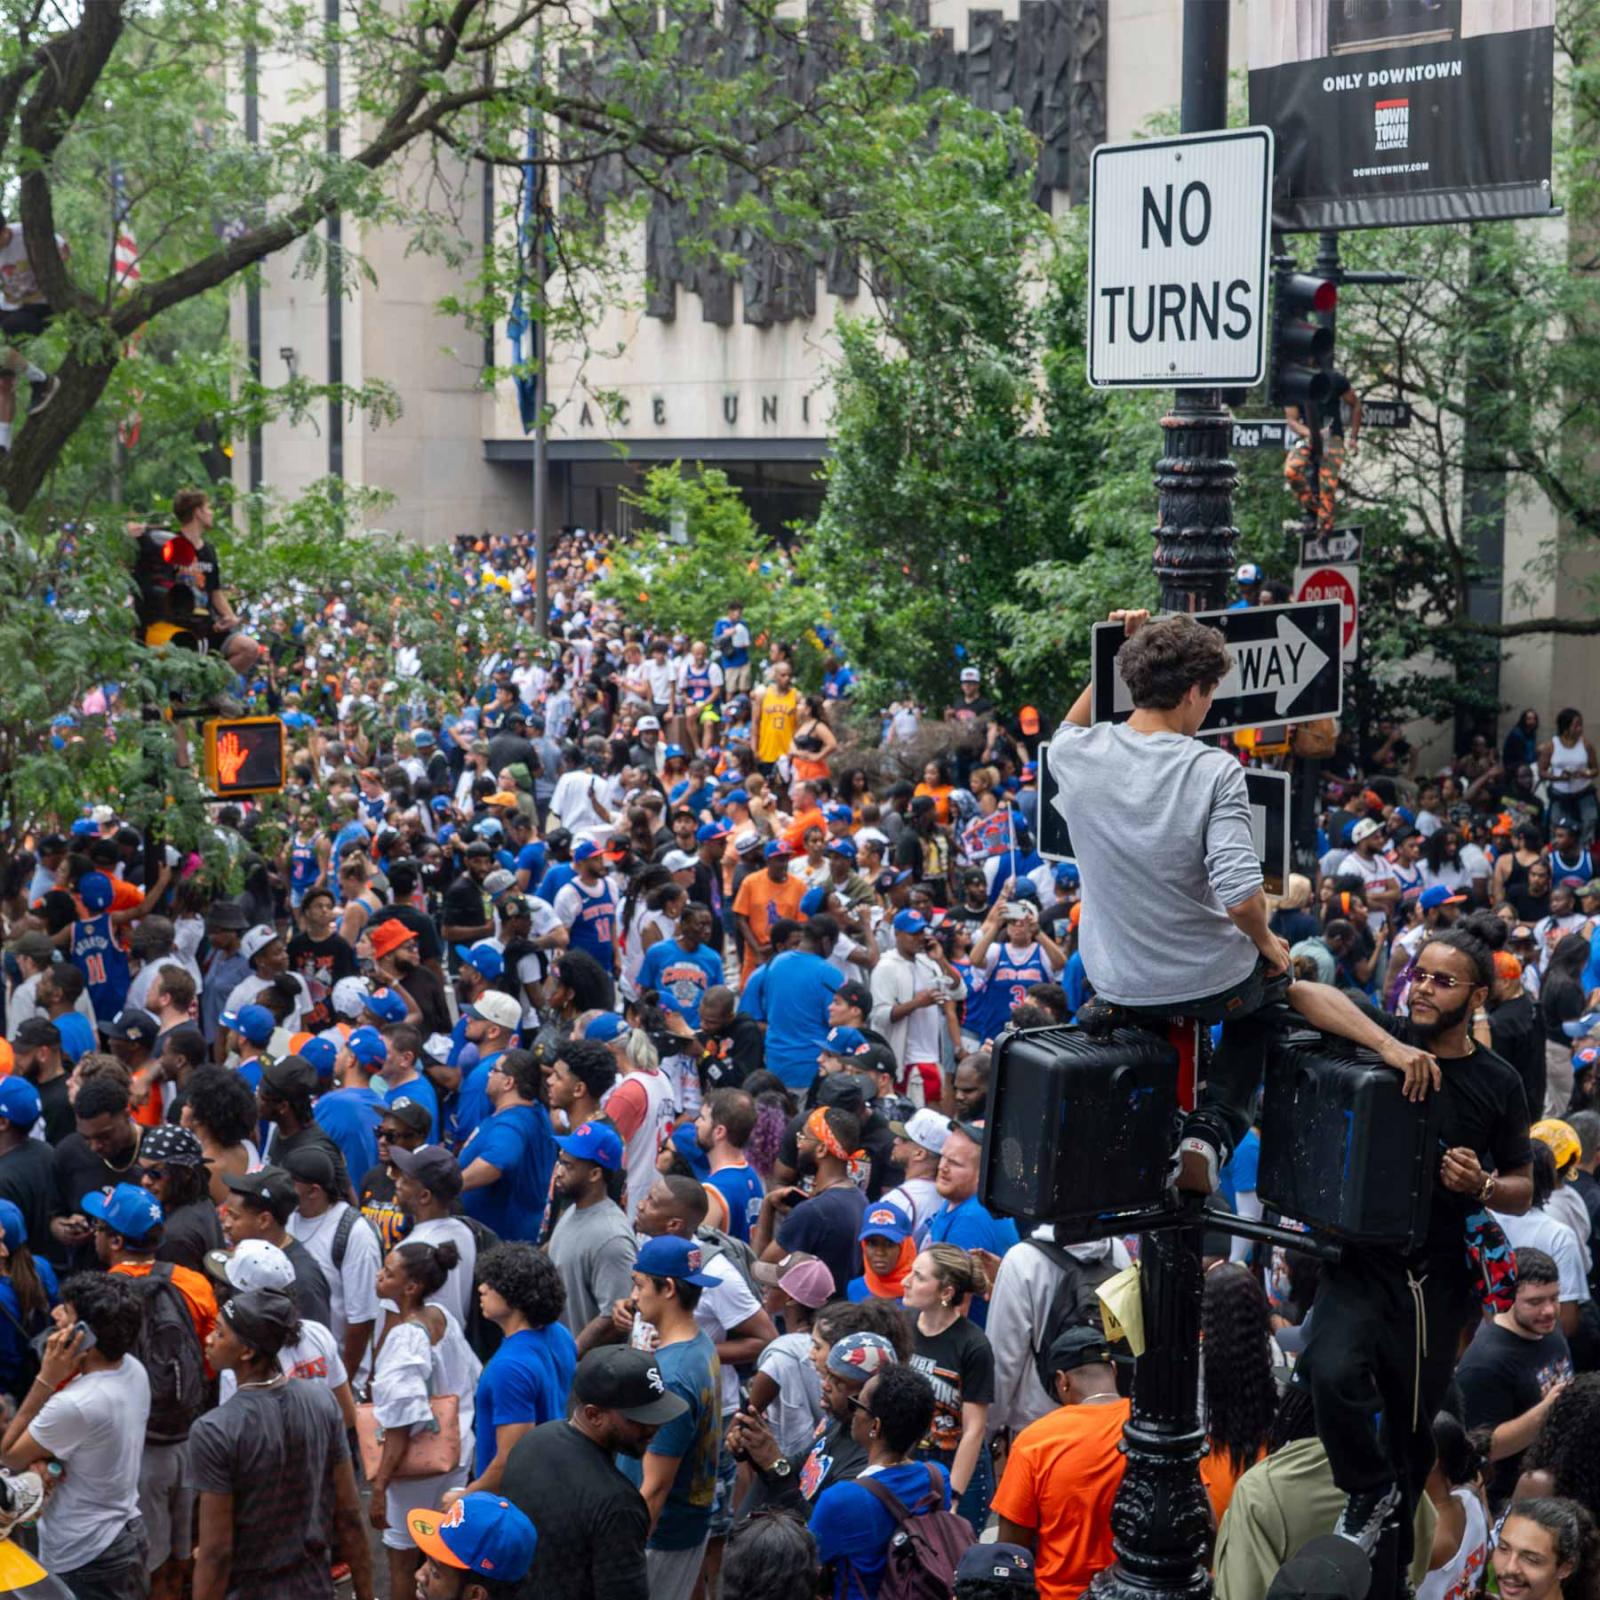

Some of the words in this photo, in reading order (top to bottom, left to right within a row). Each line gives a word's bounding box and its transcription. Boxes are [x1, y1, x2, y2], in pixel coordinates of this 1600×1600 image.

[1322, 73, 1363, 92] ONLY
[1367, 60, 1463, 87] DOWNTOWN
[1375, 106, 1409, 126] DOWN
[1375, 123, 1409, 142] TOWN
[1374, 139, 1409, 151] ALLIANCE
[1352, 162, 1429, 177] DOWNTOWNNY.COM
[1141, 180, 1212, 249] NO
[1100, 279, 1252, 344] TURNS
[1362, 403, 1396, 427] Spruce
[1232, 424, 1260, 447] Pace
[1305, 586, 1322, 600] DO
[1324, 585, 1346, 600] NOT
[1238, 642, 1306, 690] WAY
[86, 953, 107, 986] 11
[1008, 984, 1026, 1010] 3
